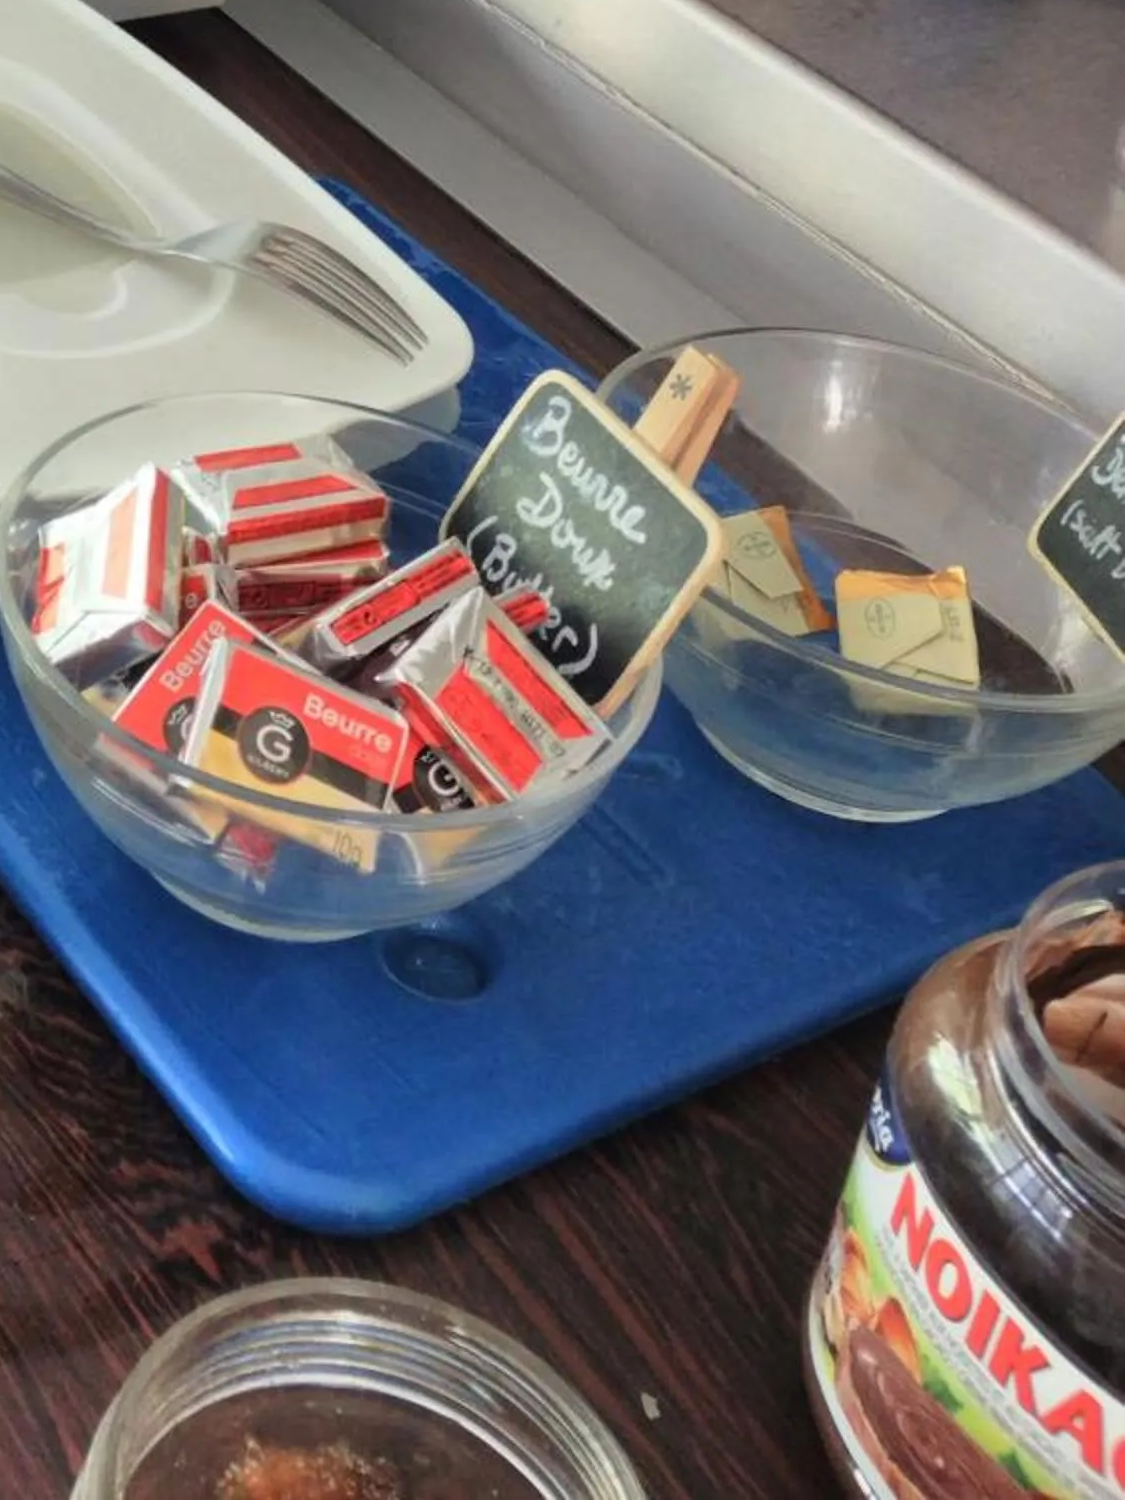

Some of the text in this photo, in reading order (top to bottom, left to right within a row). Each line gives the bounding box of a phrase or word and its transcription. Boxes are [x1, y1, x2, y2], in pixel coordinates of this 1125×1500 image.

[522, 395, 648, 544] Beurre
[516, 472, 616, 591] Doux
[159, 620, 227, 693] Beurre
[256, 725, 295, 764] G
[303, 691, 393, 753] Beurre
[890, 1171, 1125, 1492] NOIKA
